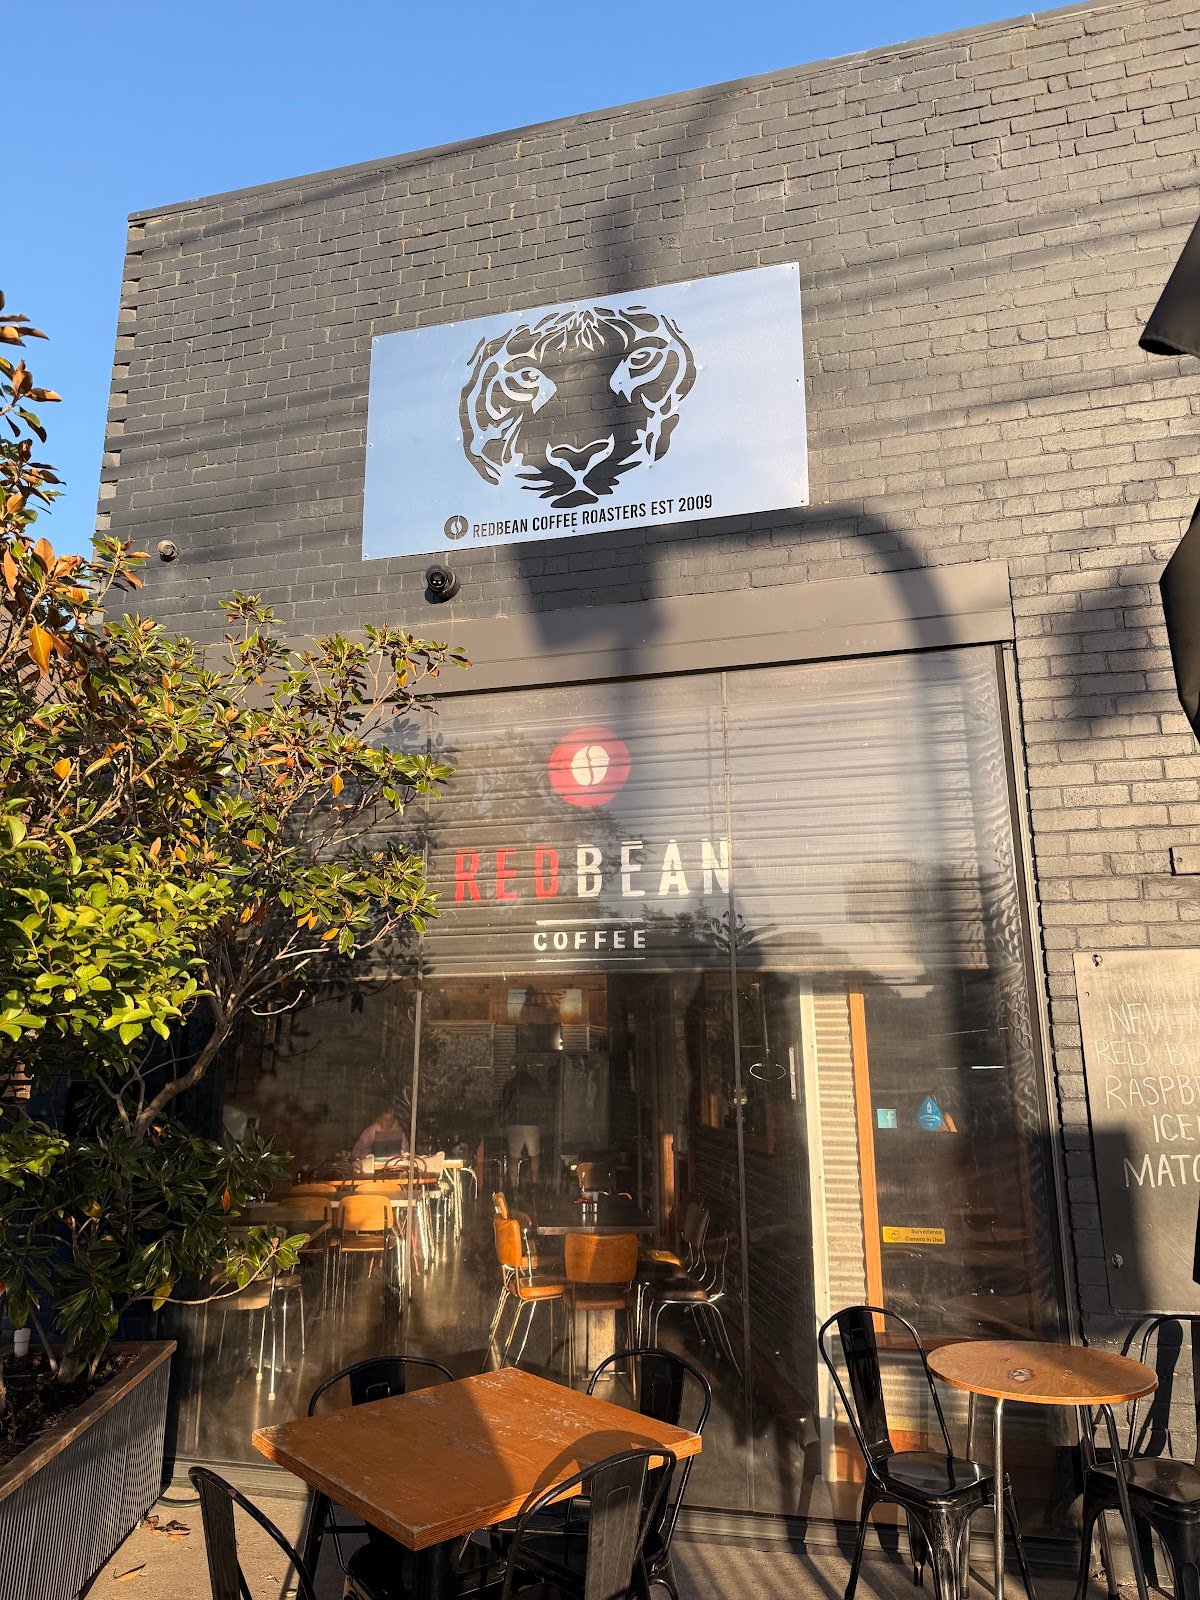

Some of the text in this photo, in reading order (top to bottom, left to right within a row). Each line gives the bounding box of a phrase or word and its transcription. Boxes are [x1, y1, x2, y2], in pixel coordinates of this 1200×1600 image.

[472, 494, 712, 539] REDBEAN COFFEE ROASTERS EST 2009
[533, 930, 646, 951] COFFEE
[1094, 1039, 1151, 1066] RED
[1105, 1074, 1200, 1109] RASPB
[1152, 1113, 1200, 1143] ICE
